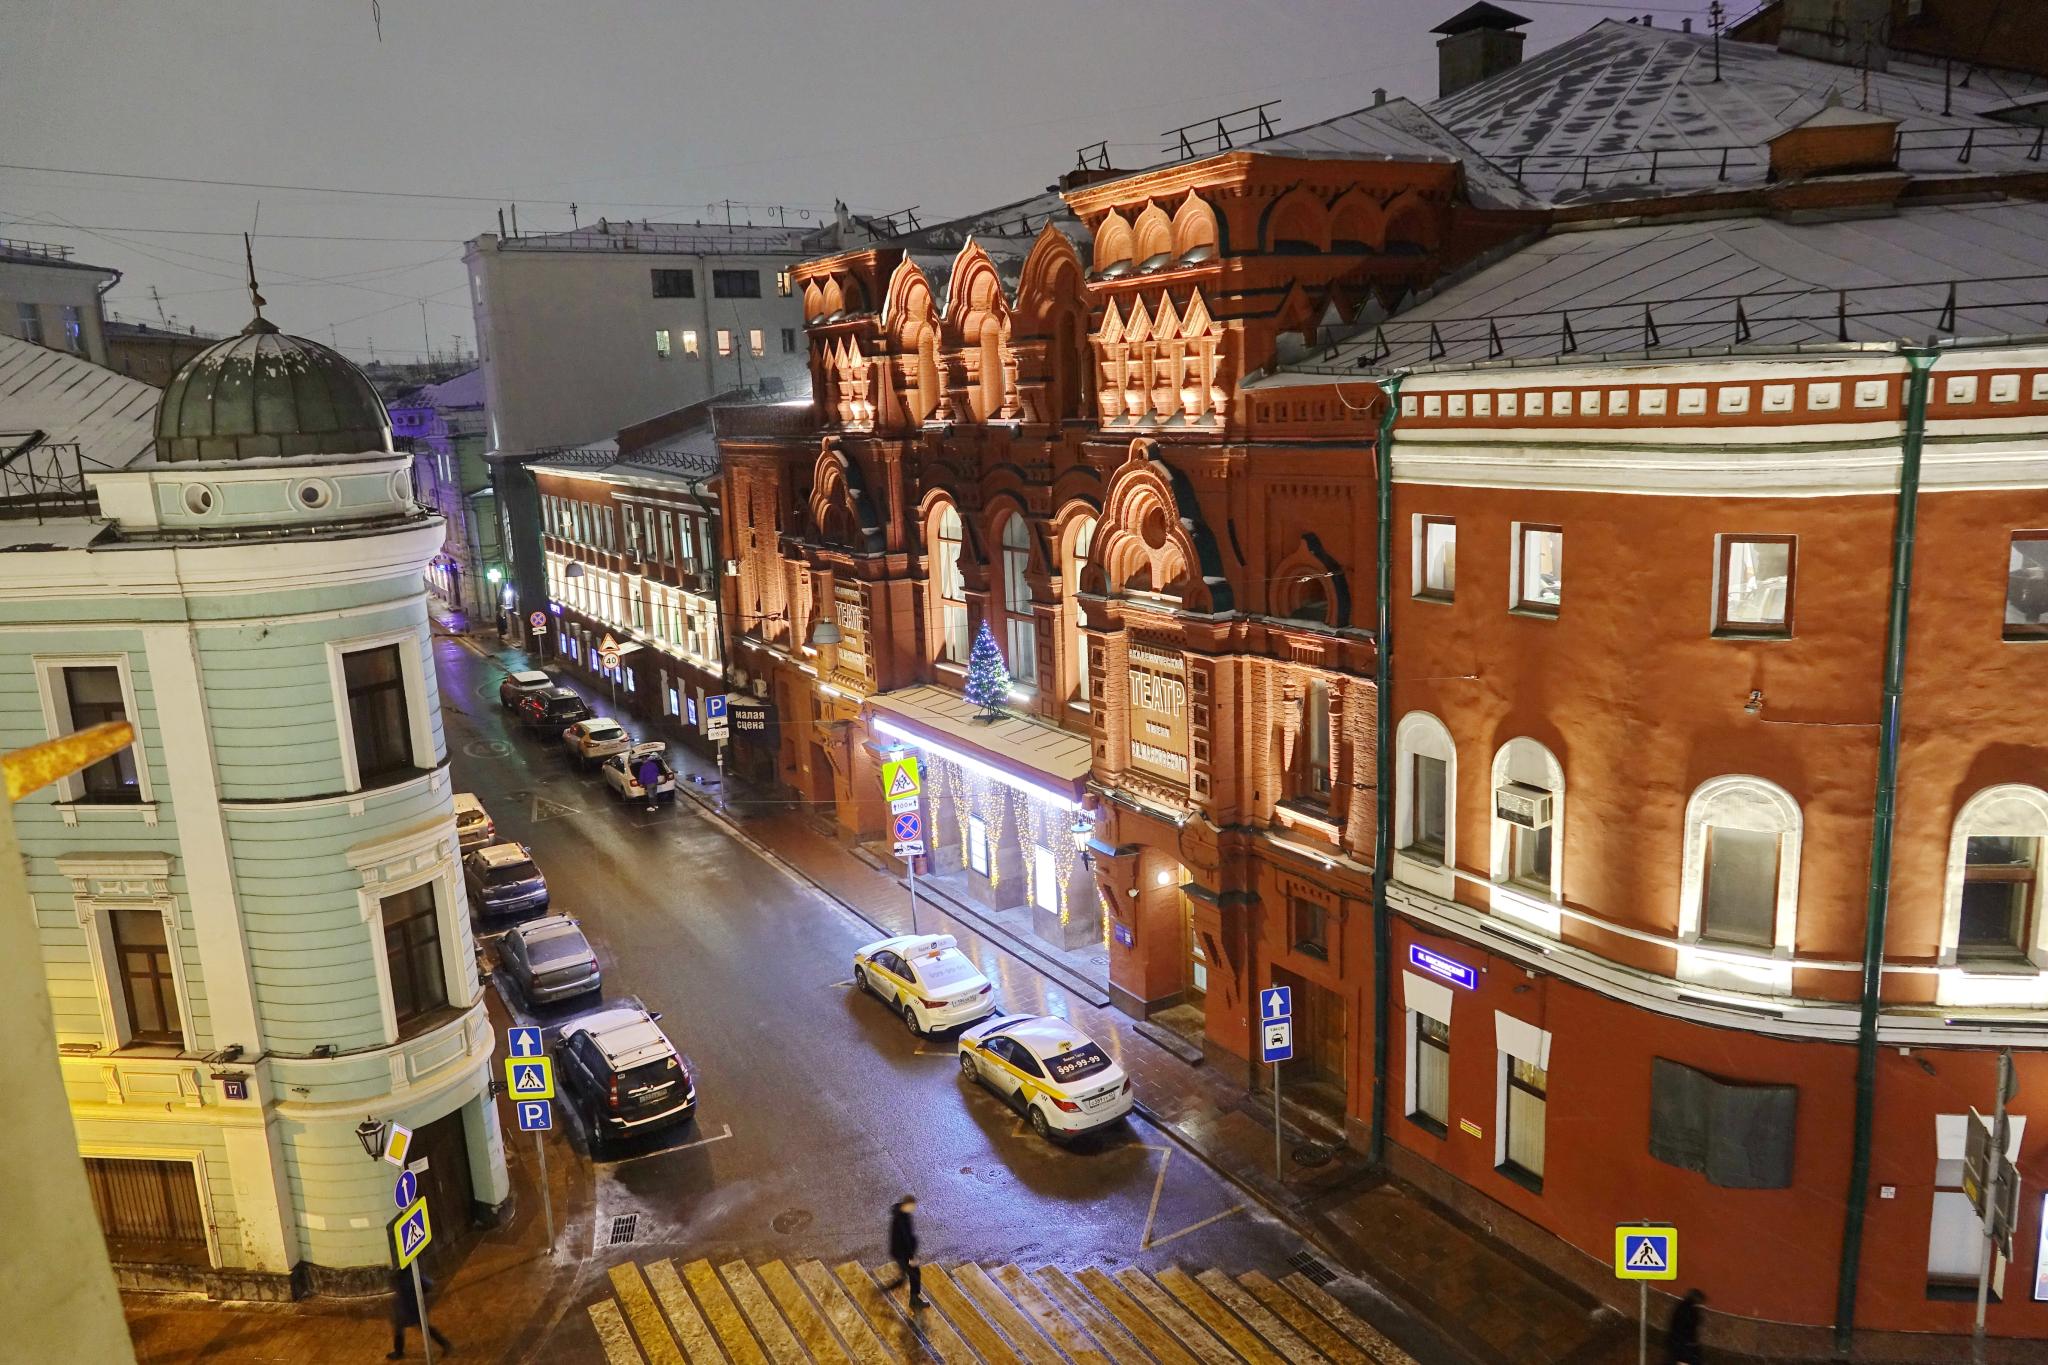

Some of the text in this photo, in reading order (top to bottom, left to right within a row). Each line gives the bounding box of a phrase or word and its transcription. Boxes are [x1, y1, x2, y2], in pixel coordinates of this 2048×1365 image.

[1129, 670, 1185, 717] ТЕАТР
[711, 699, 722, 715] P
[736, 720, 765, 730] сцена
[1058, 1055, 1101, 1075] 999-99-99
[228, 1085, 238, 1095] 17
[525, 1104, 543, 1127] P
